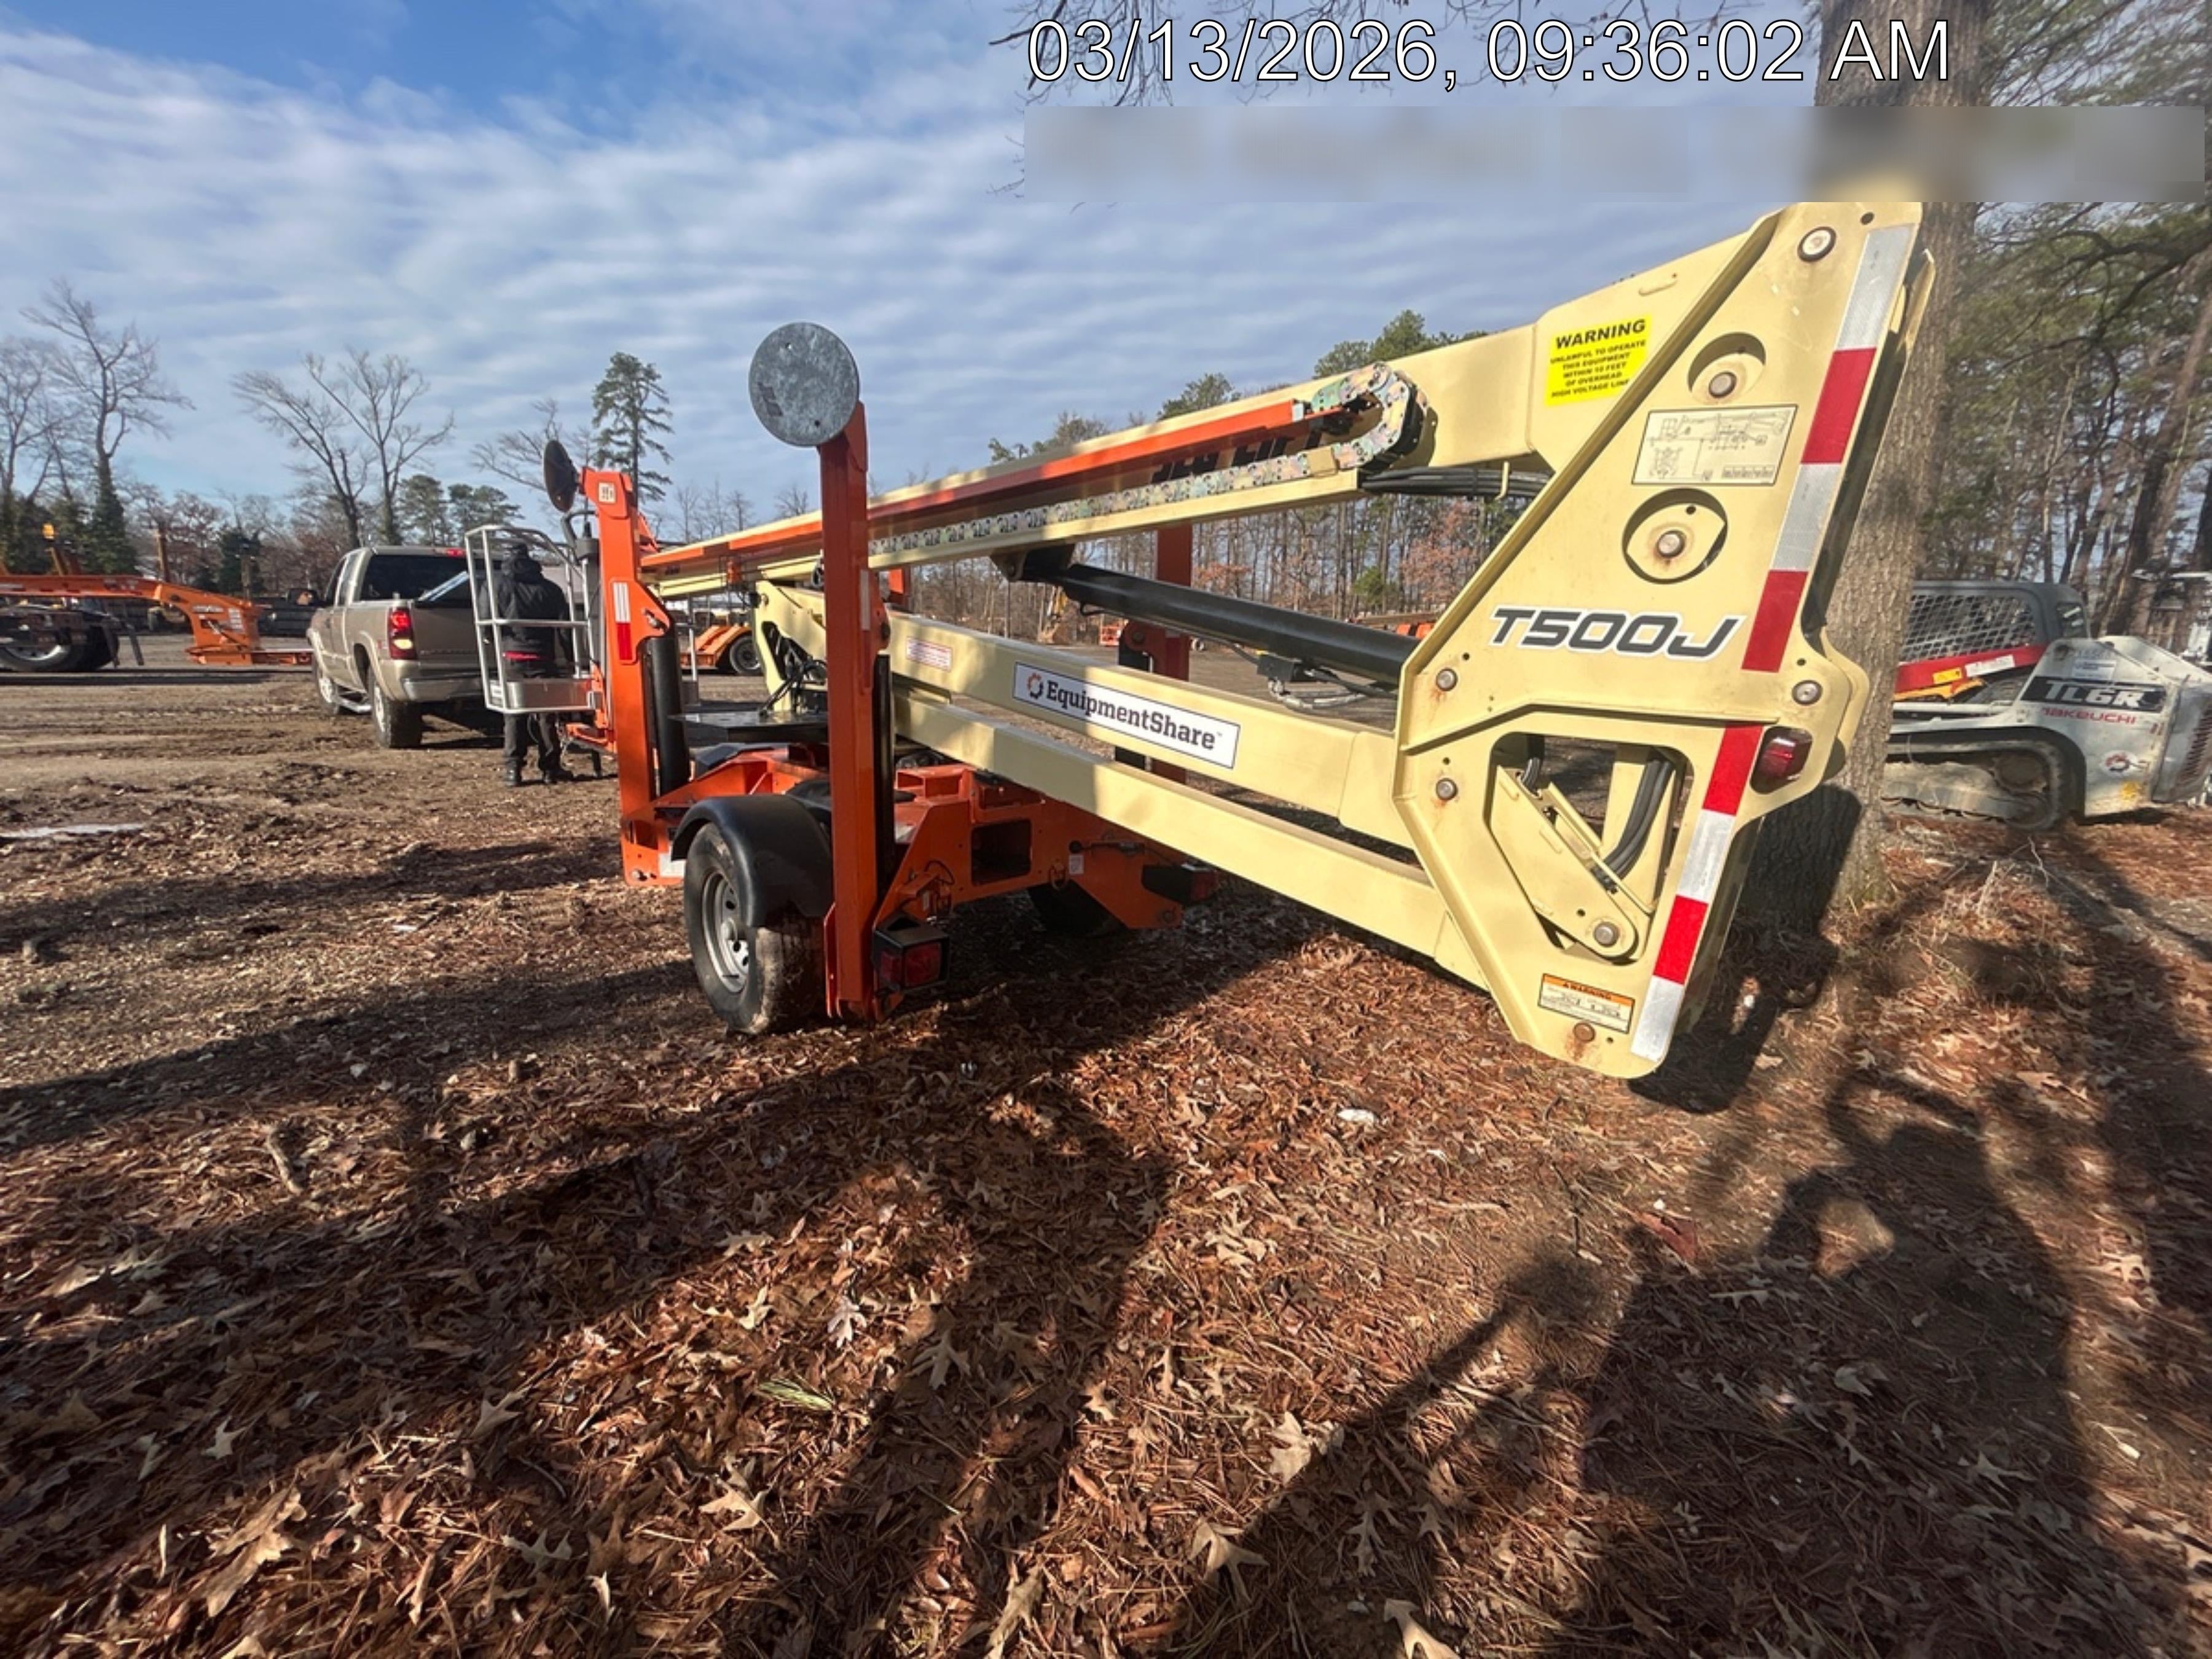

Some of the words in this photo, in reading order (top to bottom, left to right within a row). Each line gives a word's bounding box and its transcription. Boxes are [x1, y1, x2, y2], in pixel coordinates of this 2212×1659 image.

[1556, 319, 1645, 348] WARNING
[1608, 340, 1645, 351] OPERATE
[1492, 607, 1740, 658] T500J
[2044, 680, 2144, 708] TL6R
[1046, 680, 1216, 750] EquipmentShare
